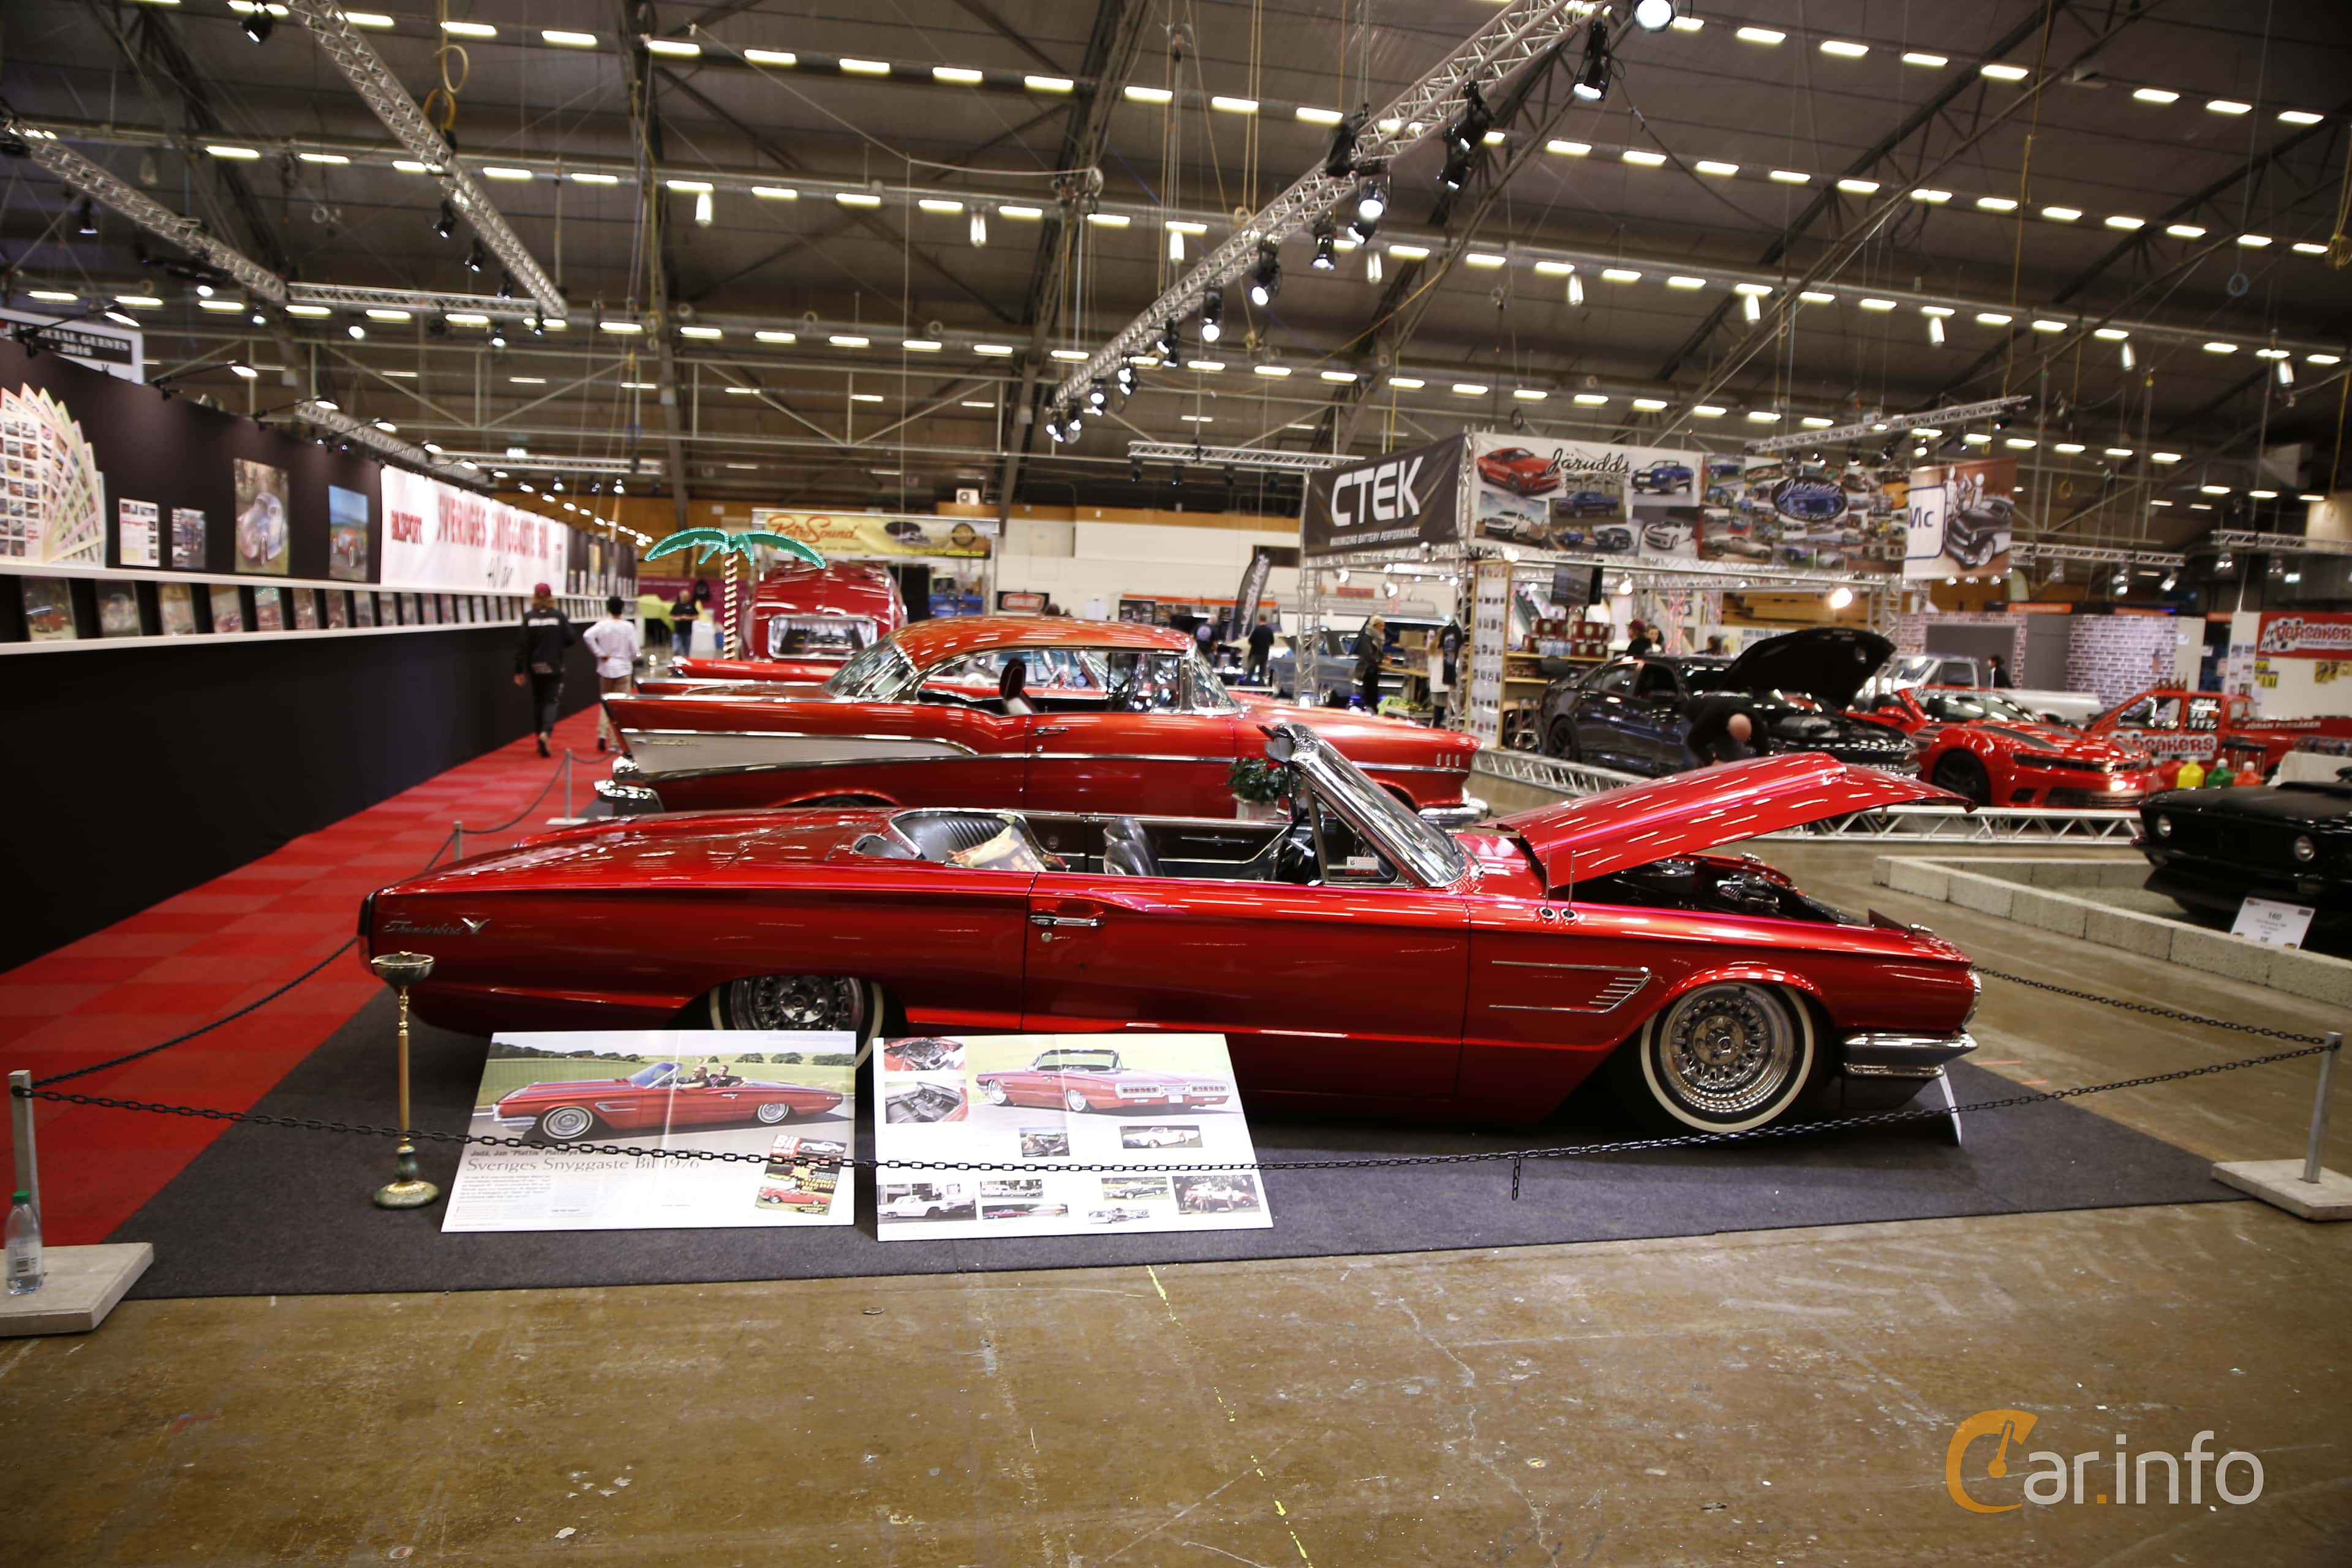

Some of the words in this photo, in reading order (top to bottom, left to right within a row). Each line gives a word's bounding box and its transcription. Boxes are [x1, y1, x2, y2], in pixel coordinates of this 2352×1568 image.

[1331, 456, 1424, 527] CTEK
[1380, 526, 1421, 541] PERFORMANCE
[773, 1134, 799, 1149] Bil
[466, 1158, 537, 1173] Sveriges
[543, 1157, 629, 1173] Snyggaste
[636, 1156, 655, 1169] Bil
